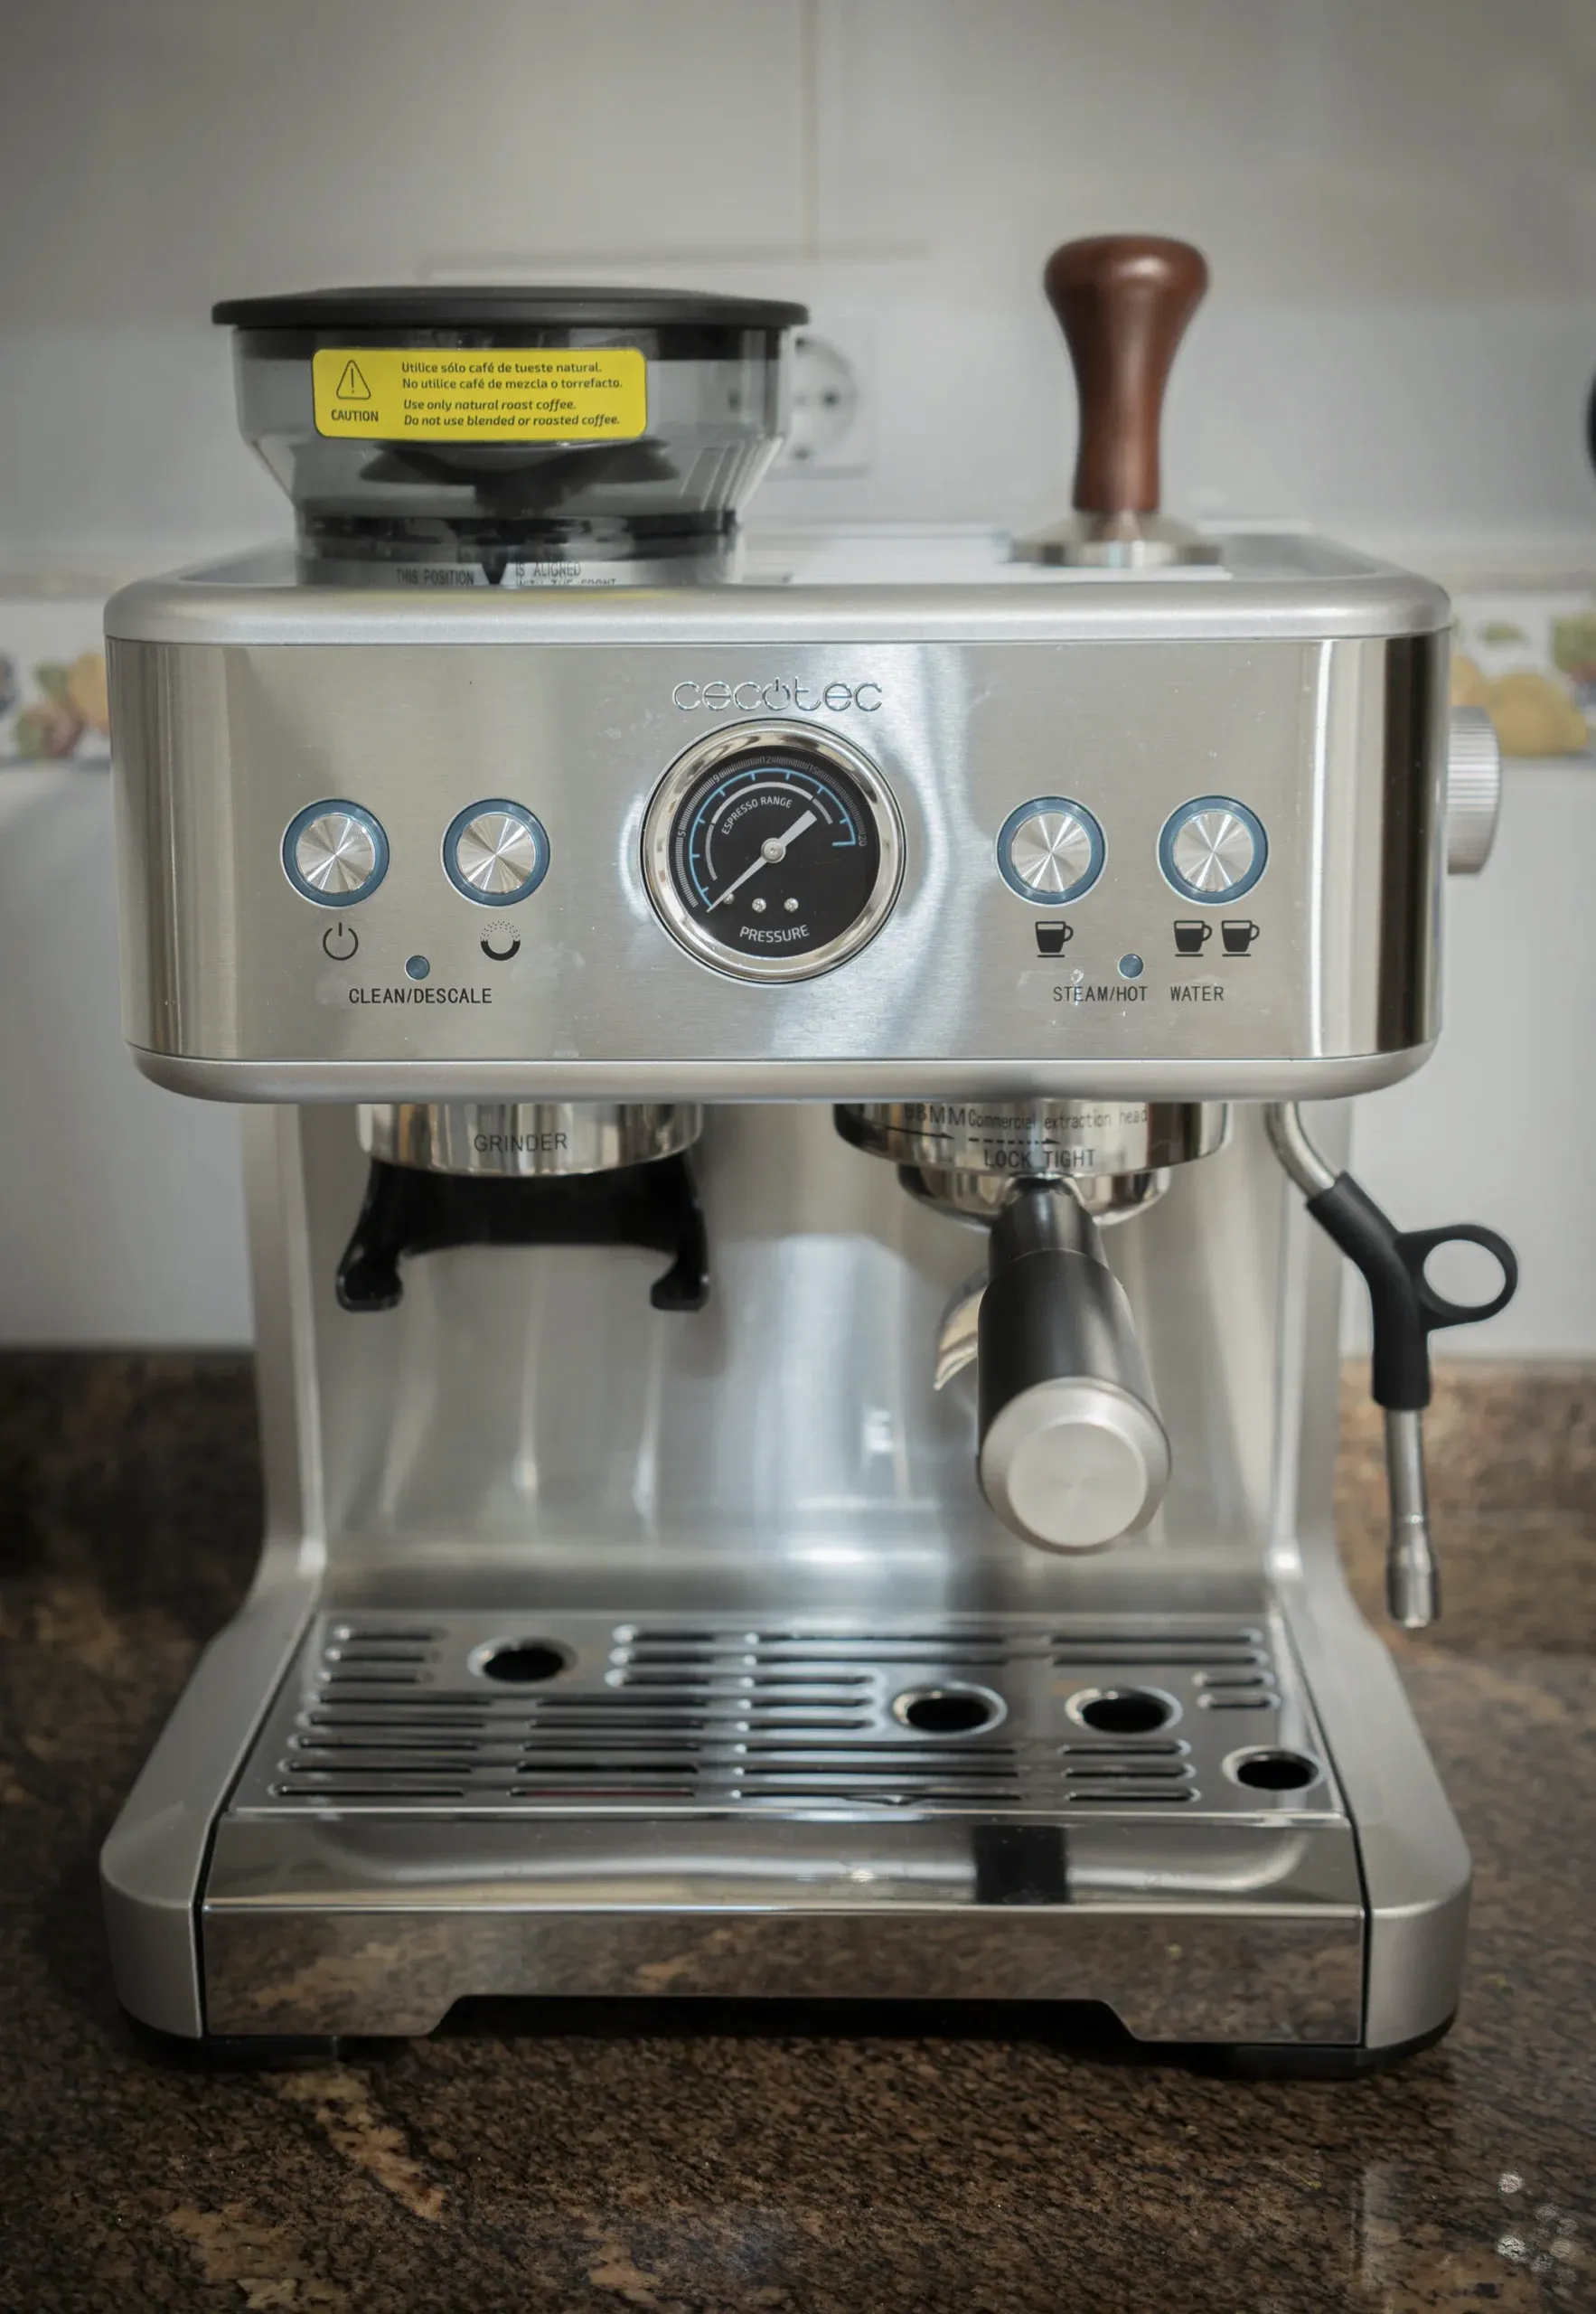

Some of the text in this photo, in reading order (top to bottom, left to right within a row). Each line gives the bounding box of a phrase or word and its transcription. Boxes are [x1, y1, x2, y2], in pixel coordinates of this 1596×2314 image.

[401, 362, 602, 373] Utilice sólo café de tueste natural.
[402, 377, 623, 390] No utilice café de mezcla o torrefacto.
[403, 399, 577, 412] Use only natural roast coffee.
[331, 409, 379, 423] CAUTION
[404, 413, 621, 428] Do not use blended or roasted coffee.
[396, 568, 474, 586] THIS POSITION
[534, 561, 582, 577] ALIGNED
[671, 676, 883, 711] cecotec
[713, 774, 720, 783] 9
[721, 795, 793, 835] ESPRESSO RANGE
[858, 832, 868, 847] 20
[739, 924, 810, 943] PRESSURE
[350, 988, 493, 1004] CLEAN/DESCALE
[1053, 986, 1225, 1002] STEAM/HOT WATER
[969, 1109, 1036, 1130] Commercial
[1045, 1109, 1111, 1130] extraction
[1119, 1106, 1148, 1124] head
[474, 1133, 568, 1153] GRINDER
[984, 1149, 1095, 1169] LOCK TIGHT
